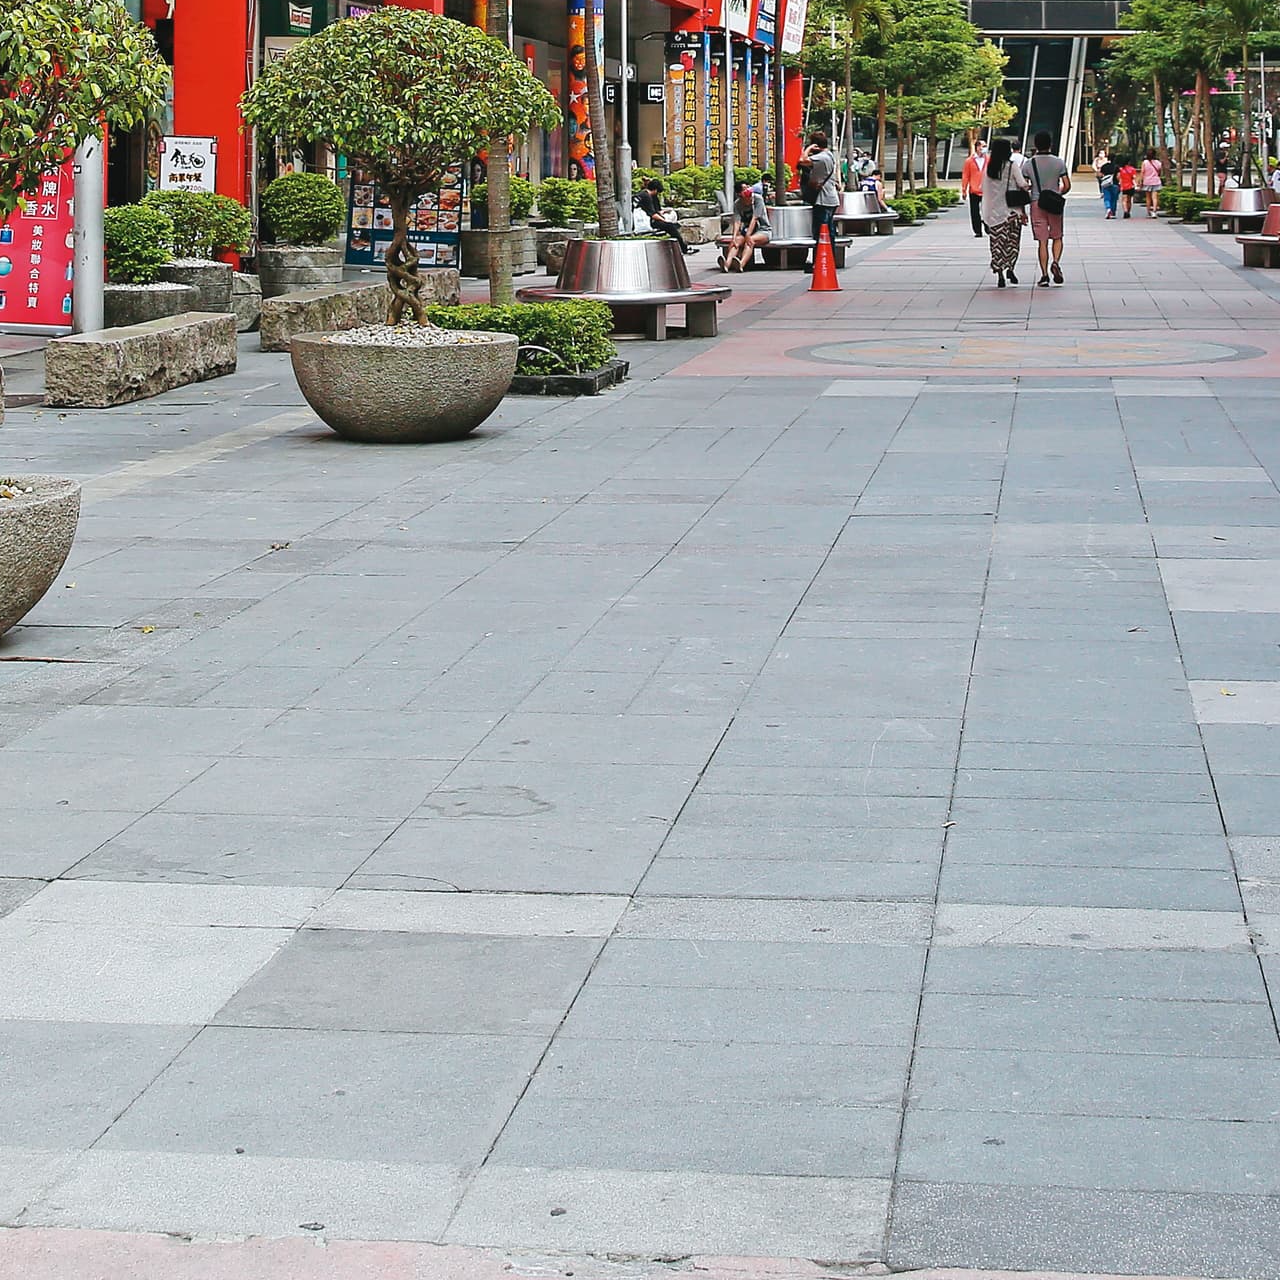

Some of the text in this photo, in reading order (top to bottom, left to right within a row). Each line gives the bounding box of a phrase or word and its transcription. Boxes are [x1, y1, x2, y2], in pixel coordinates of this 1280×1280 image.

[24, 201, 56, 216] 香水
[27, 225, 44, 308] 美妝聯合特賣
